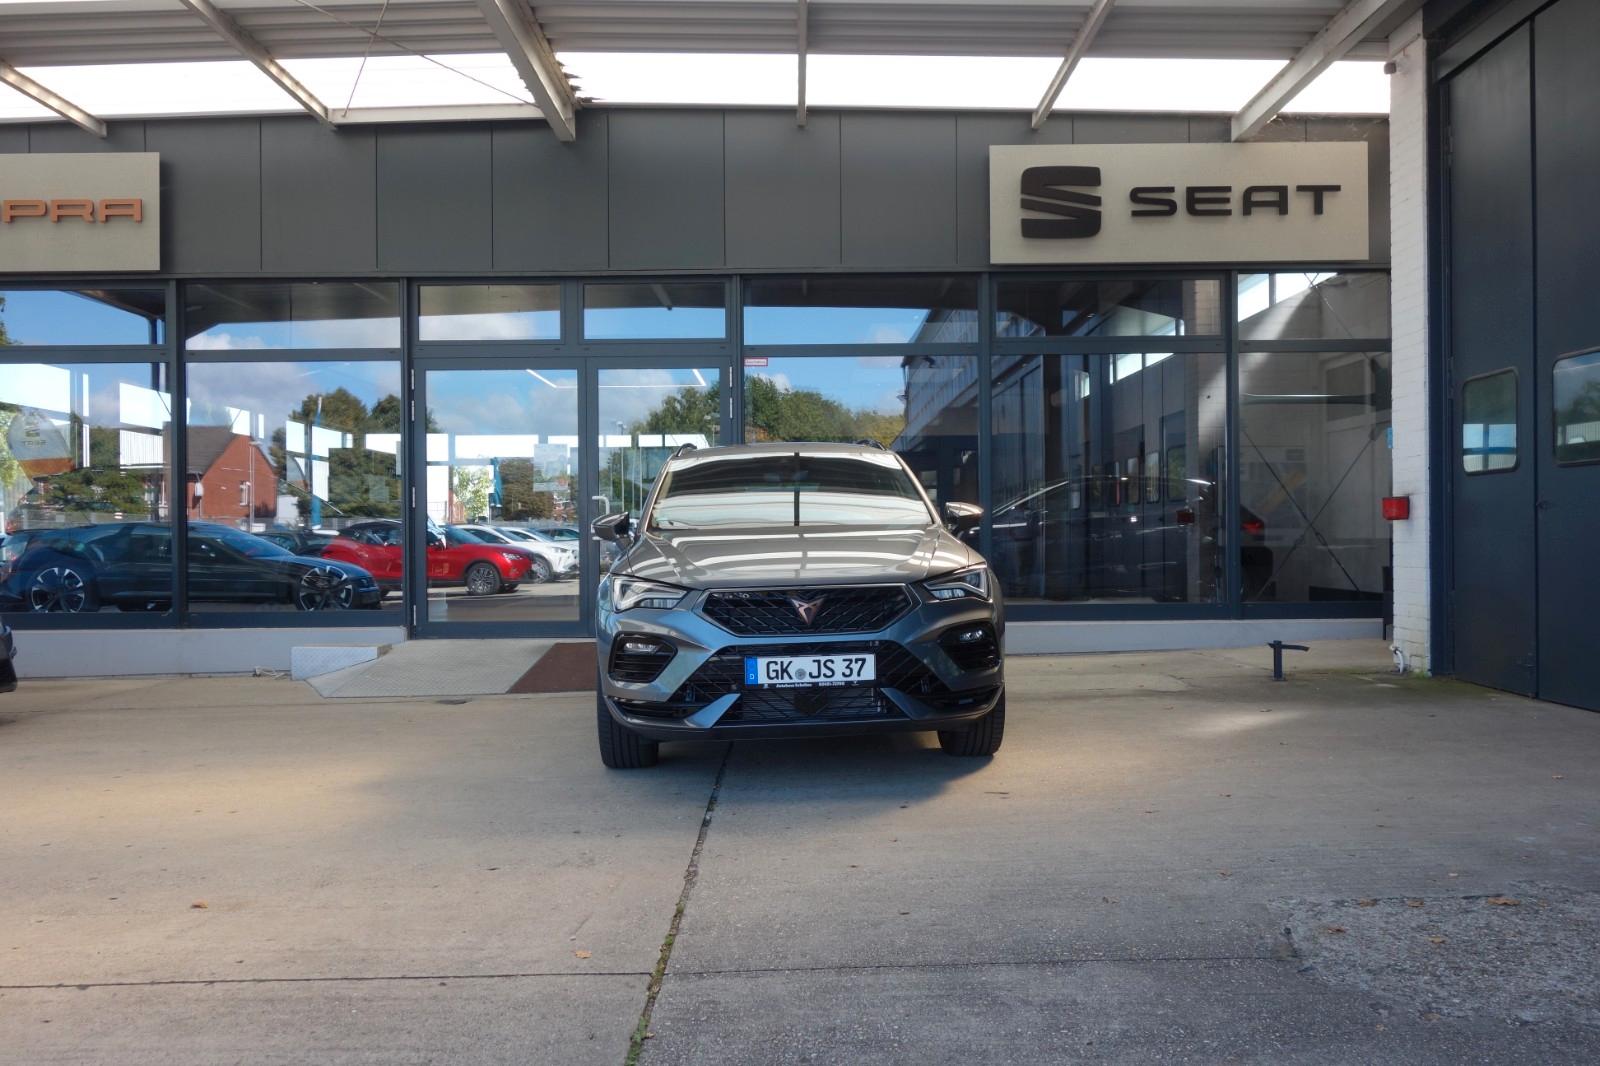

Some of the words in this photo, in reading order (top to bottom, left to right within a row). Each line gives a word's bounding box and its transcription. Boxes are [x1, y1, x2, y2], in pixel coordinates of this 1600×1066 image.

[0, 199, 142, 223] PRA
[1130, 185, 1341, 216] SEAT
[766, 660, 793, 680] GK
[808, 659, 835, 679] JS
[841, 657, 867, 678] 37
